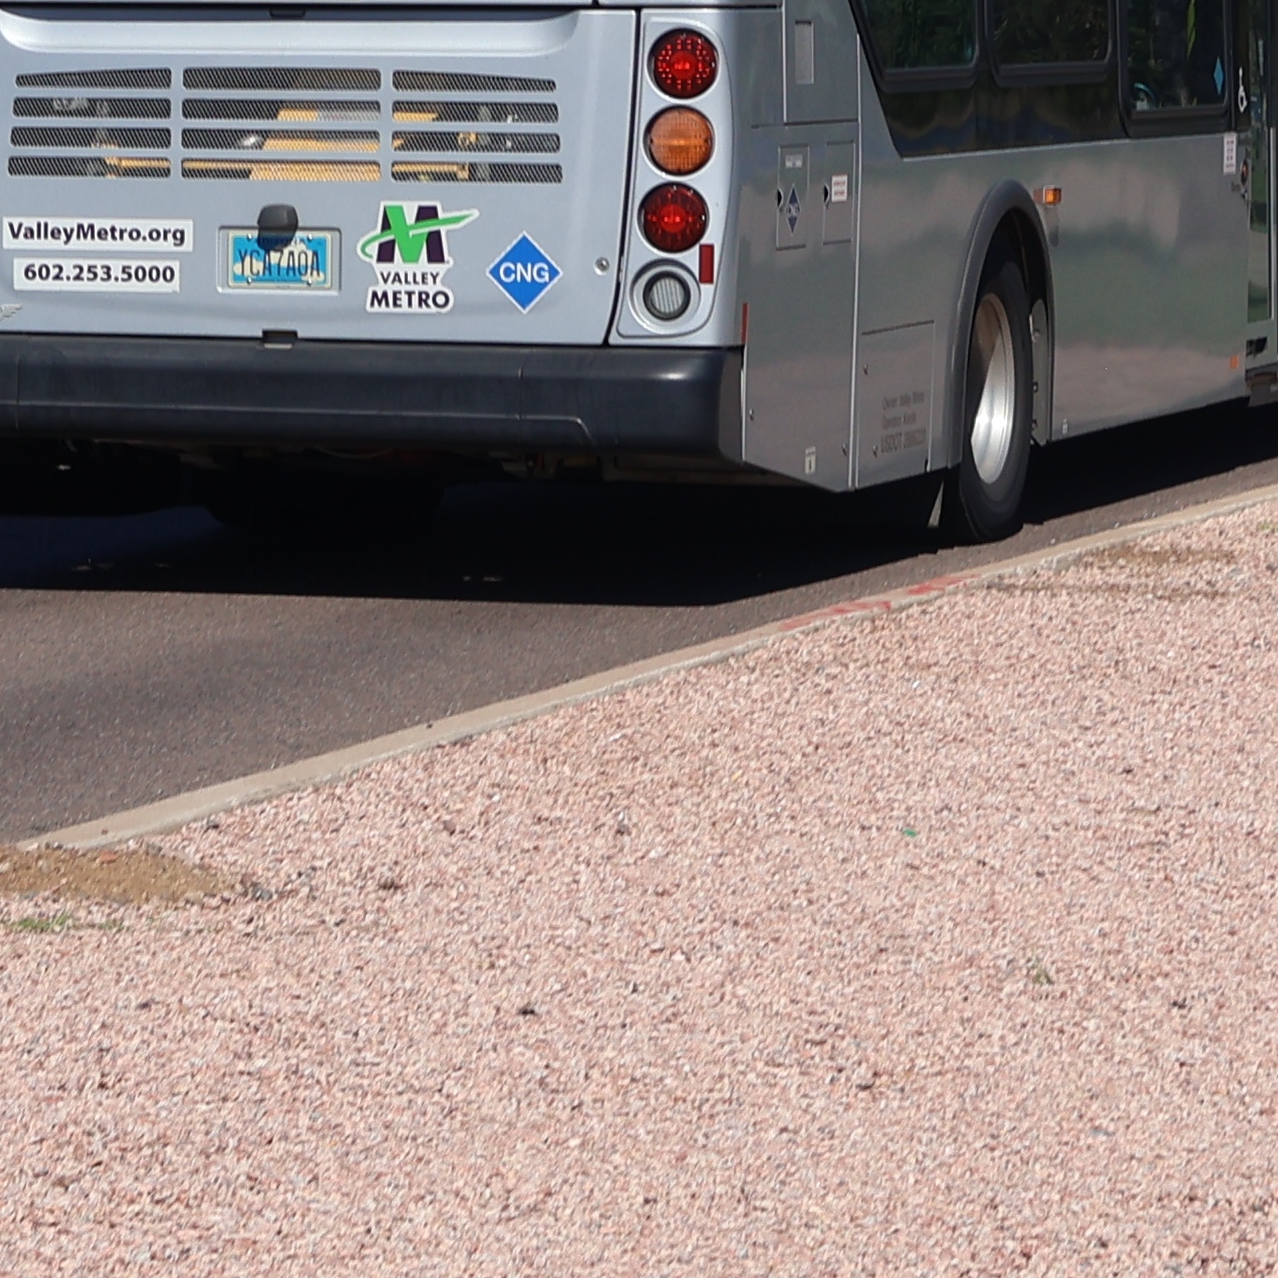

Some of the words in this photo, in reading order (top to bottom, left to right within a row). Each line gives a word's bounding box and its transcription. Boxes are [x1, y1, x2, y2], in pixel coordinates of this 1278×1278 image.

[8, 221, 185, 247] ValleyMetro.org
[24, 263, 175, 283] 602.253.5000
[380, 271, 440, 285] VALLEY
[499, 262, 549, 283] CNG
[370, 290, 450, 309] METRO
